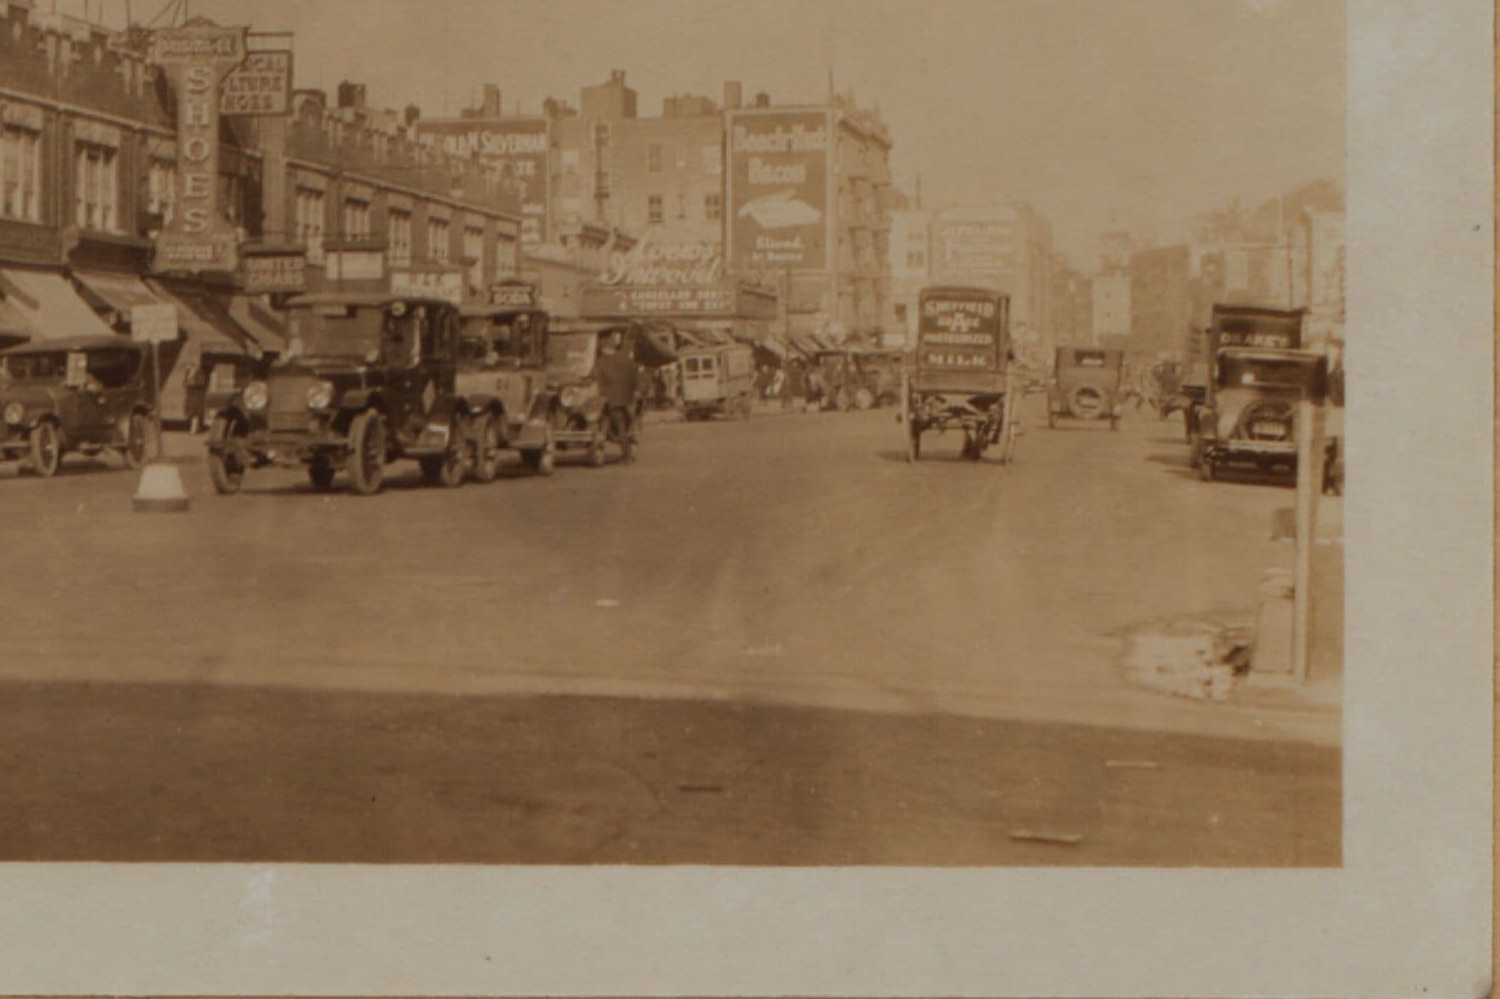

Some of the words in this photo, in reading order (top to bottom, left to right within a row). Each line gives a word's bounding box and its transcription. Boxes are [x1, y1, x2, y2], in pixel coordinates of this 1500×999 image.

[183, 66, 212, 234] SHOES
[923, 300, 995, 318] SHEFFIELD
[923, 333, 994, 345] PASTEURIZED
[927, 353, 987, 366] MILK
